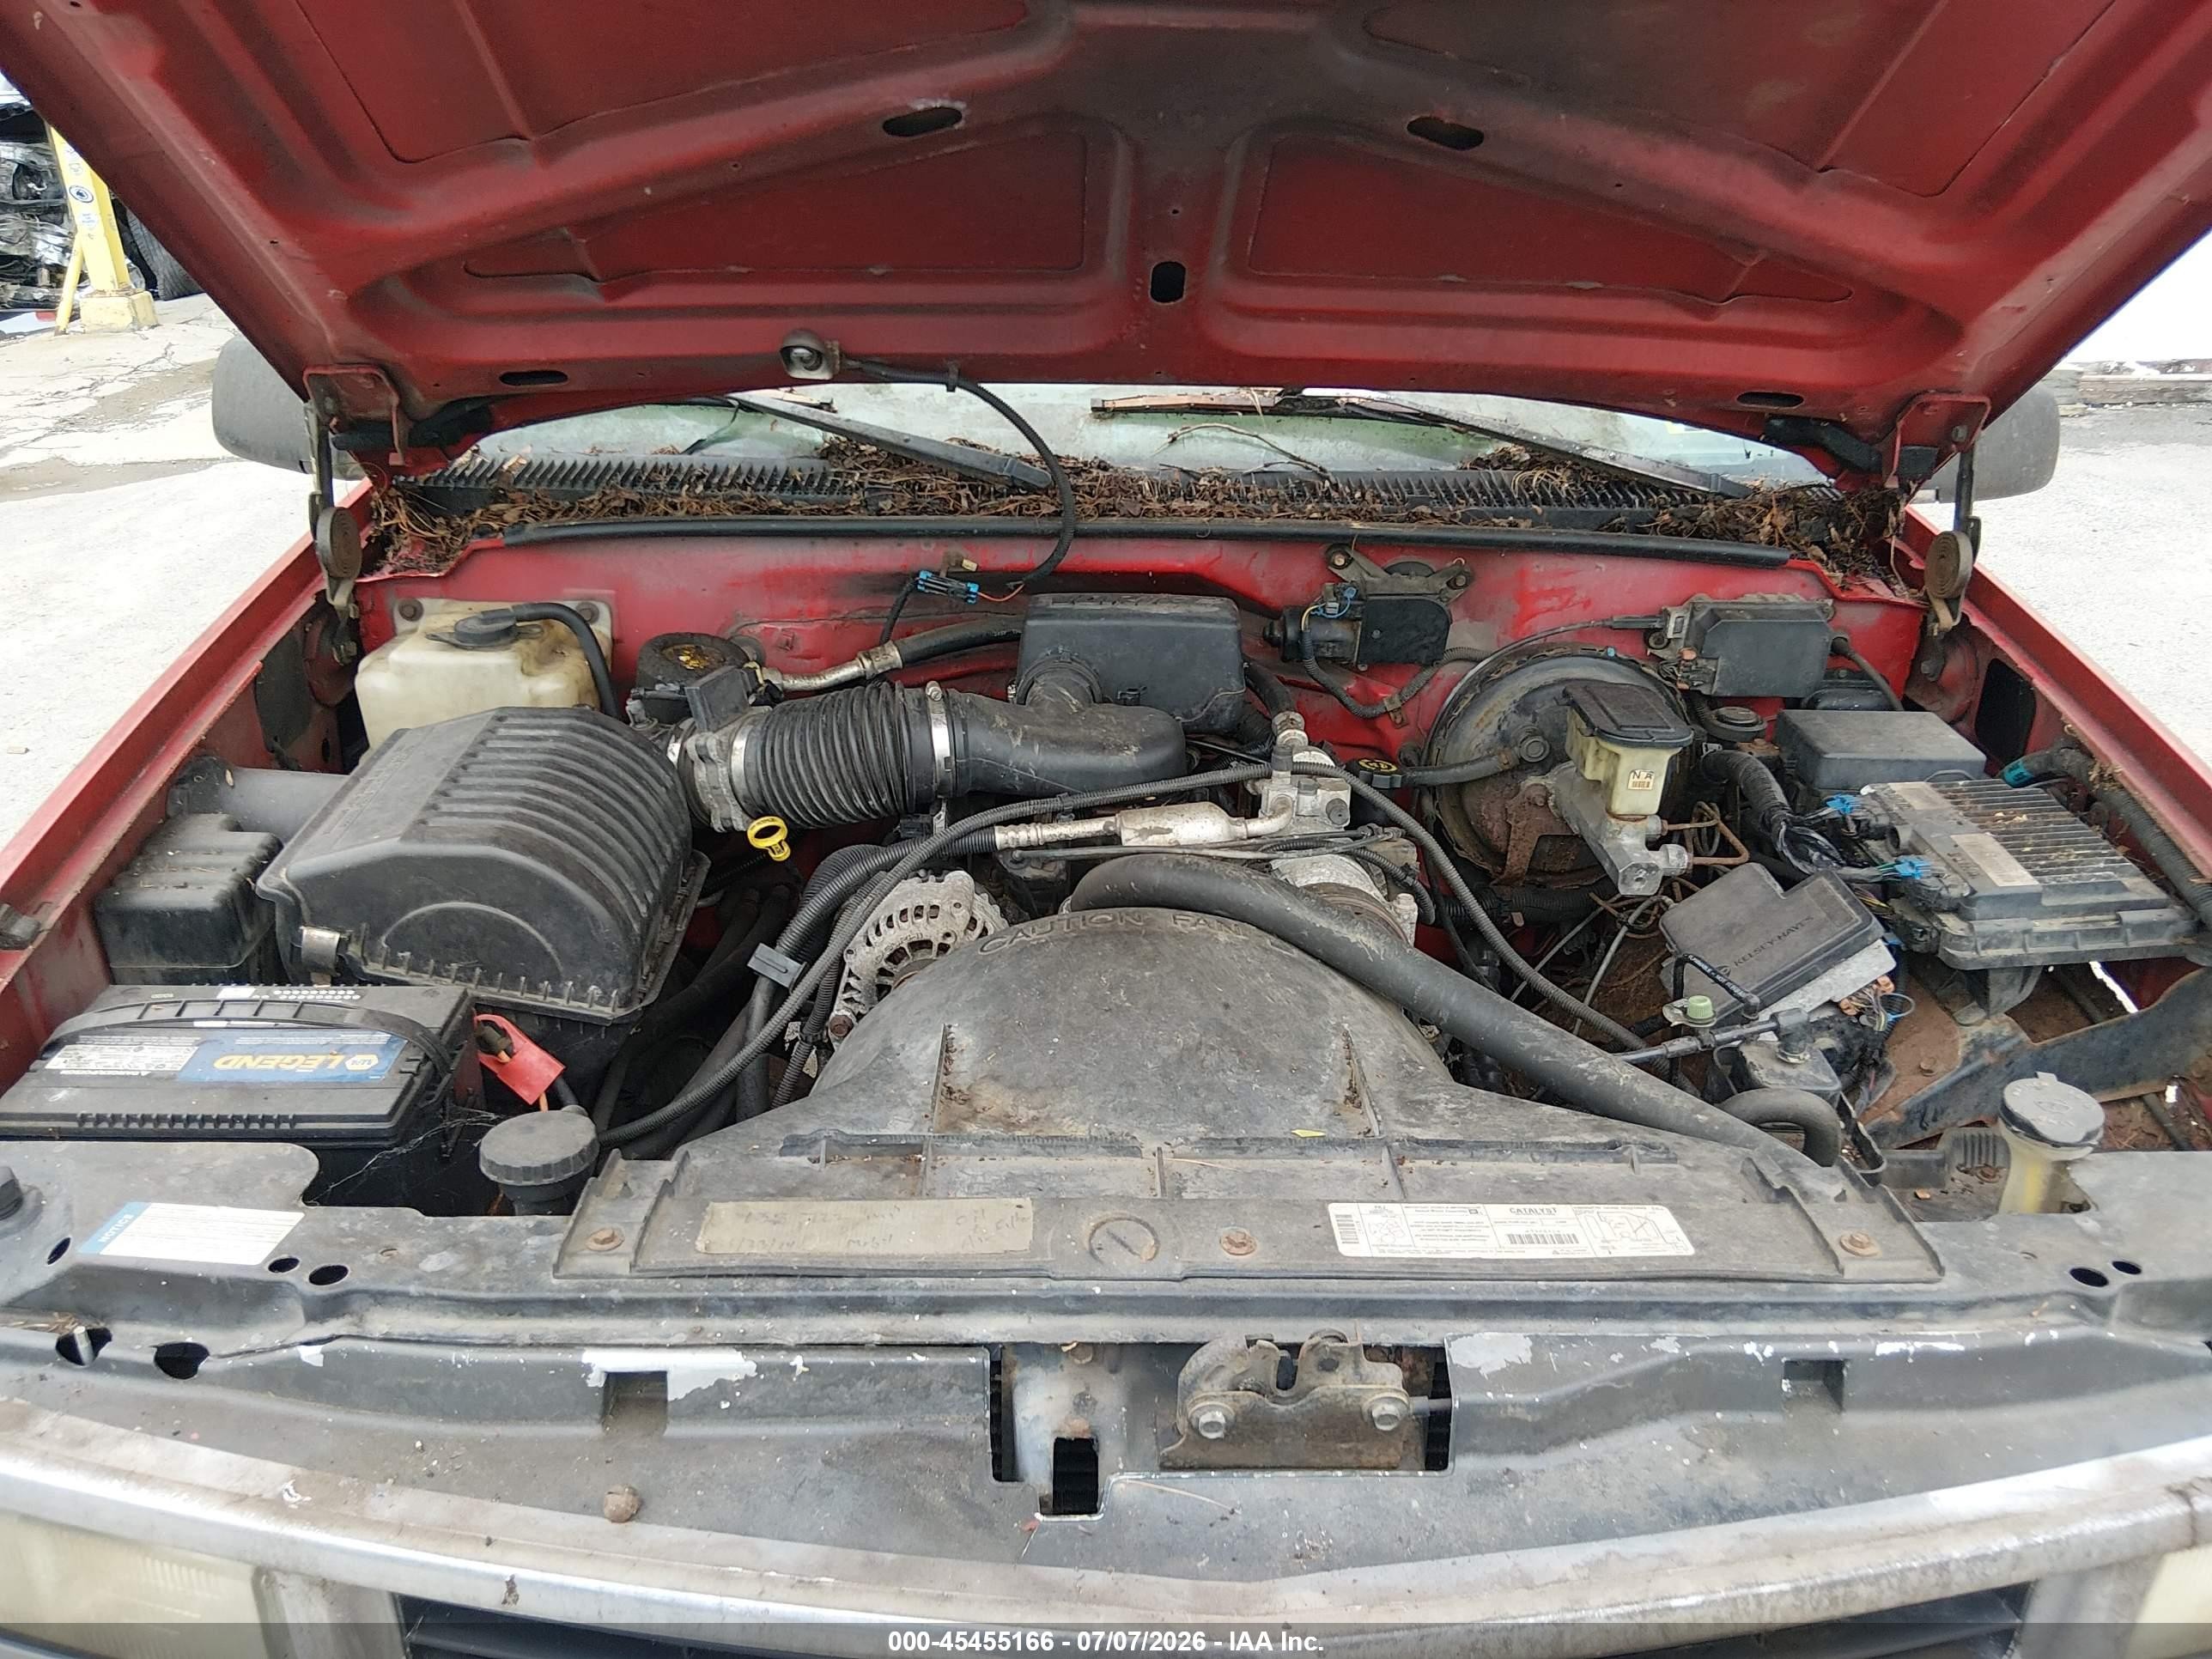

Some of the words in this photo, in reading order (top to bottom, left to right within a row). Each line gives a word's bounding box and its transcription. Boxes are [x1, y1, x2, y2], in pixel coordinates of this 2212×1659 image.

[978, 914, 1146, 956] CAUTION
[1171, 914, 1250, 940] FAN
[214, 1054, 345, 1071] LEGEND
[1509, 1206, 1559, 1215] CATALYST
[98, 1213, 135, 1243] NOTICE
